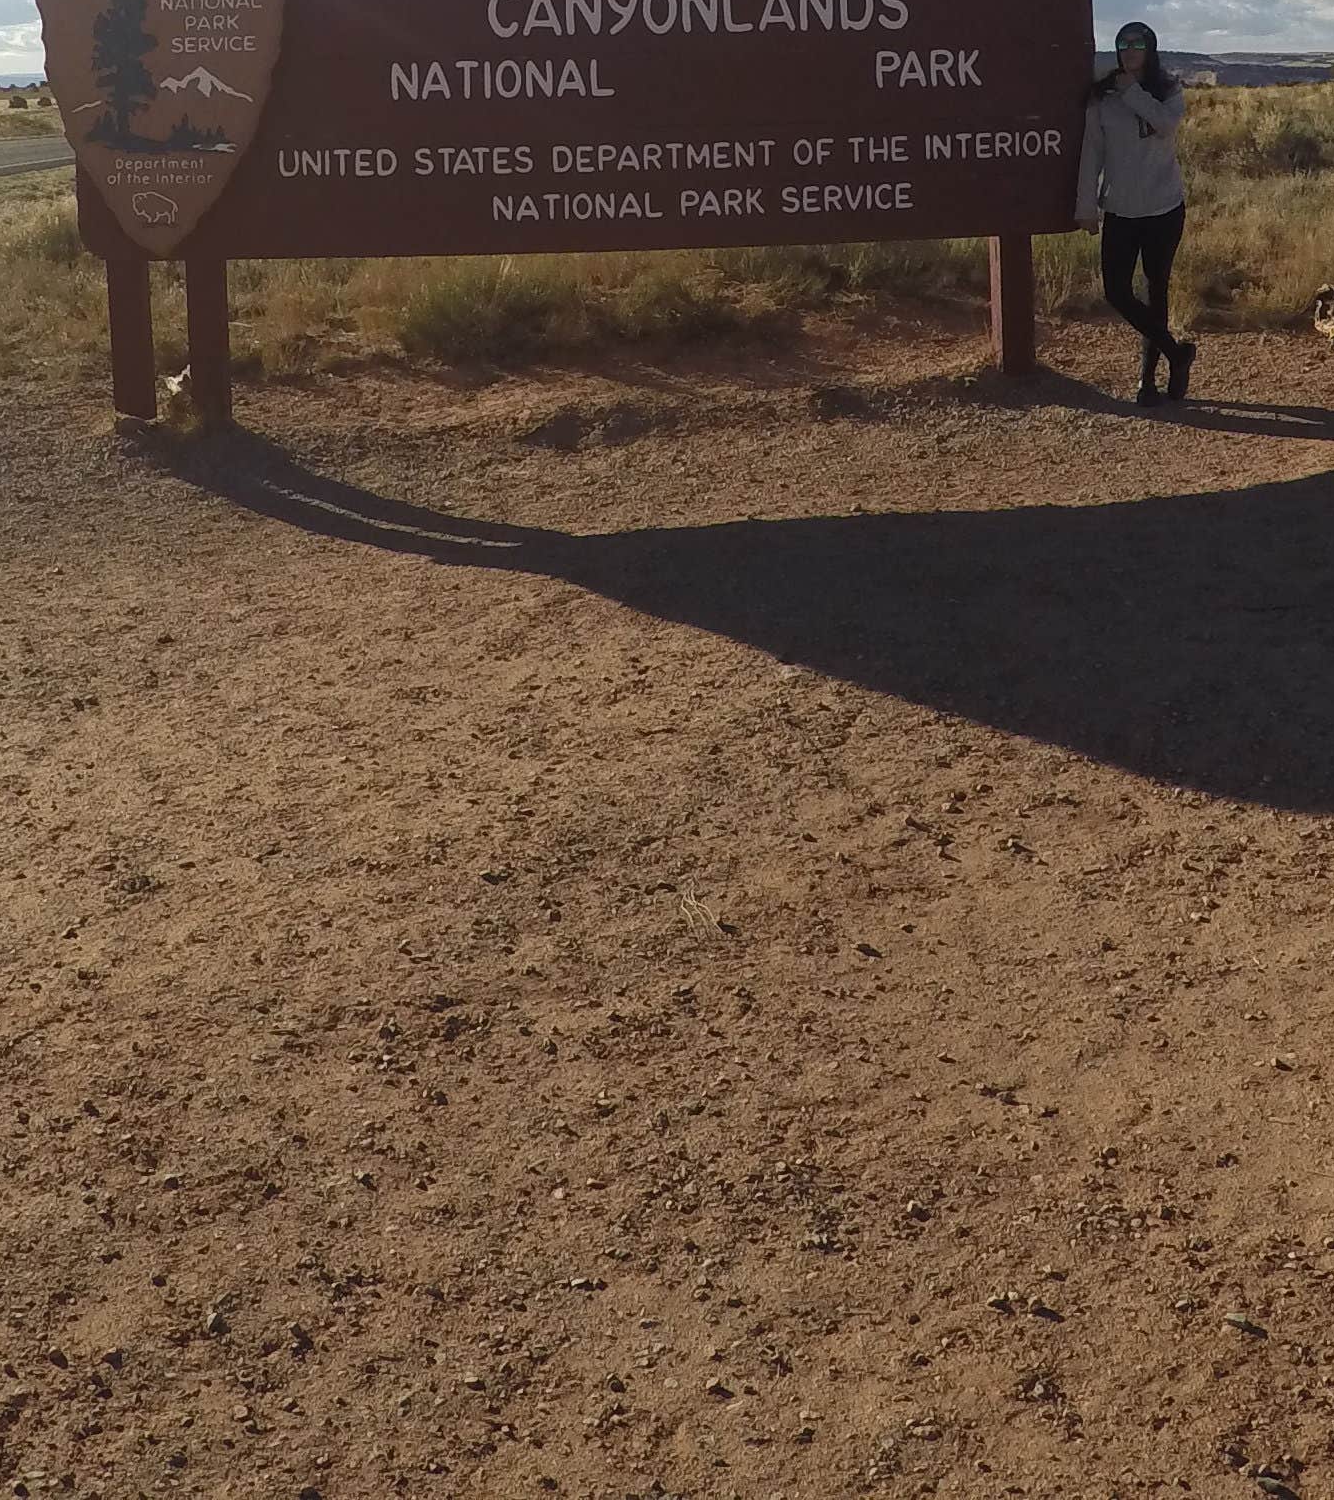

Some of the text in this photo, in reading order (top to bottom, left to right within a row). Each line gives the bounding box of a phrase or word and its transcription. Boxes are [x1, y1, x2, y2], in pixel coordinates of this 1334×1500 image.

[184, 15, 239, 31] PARK
[171, 35, 257, 54] SERVICE
[390, 49, 982, 101] NATIONAL PARK
[278, 129, 1062, 177] UNITED STATES DEPARTMENT OF THE INTERIOR
[115, 157, 205, 171] Department
[107, 172, 214, 186] of the Interior
[492, 183, 914, 221] NATIONAL PARK SERVICE
